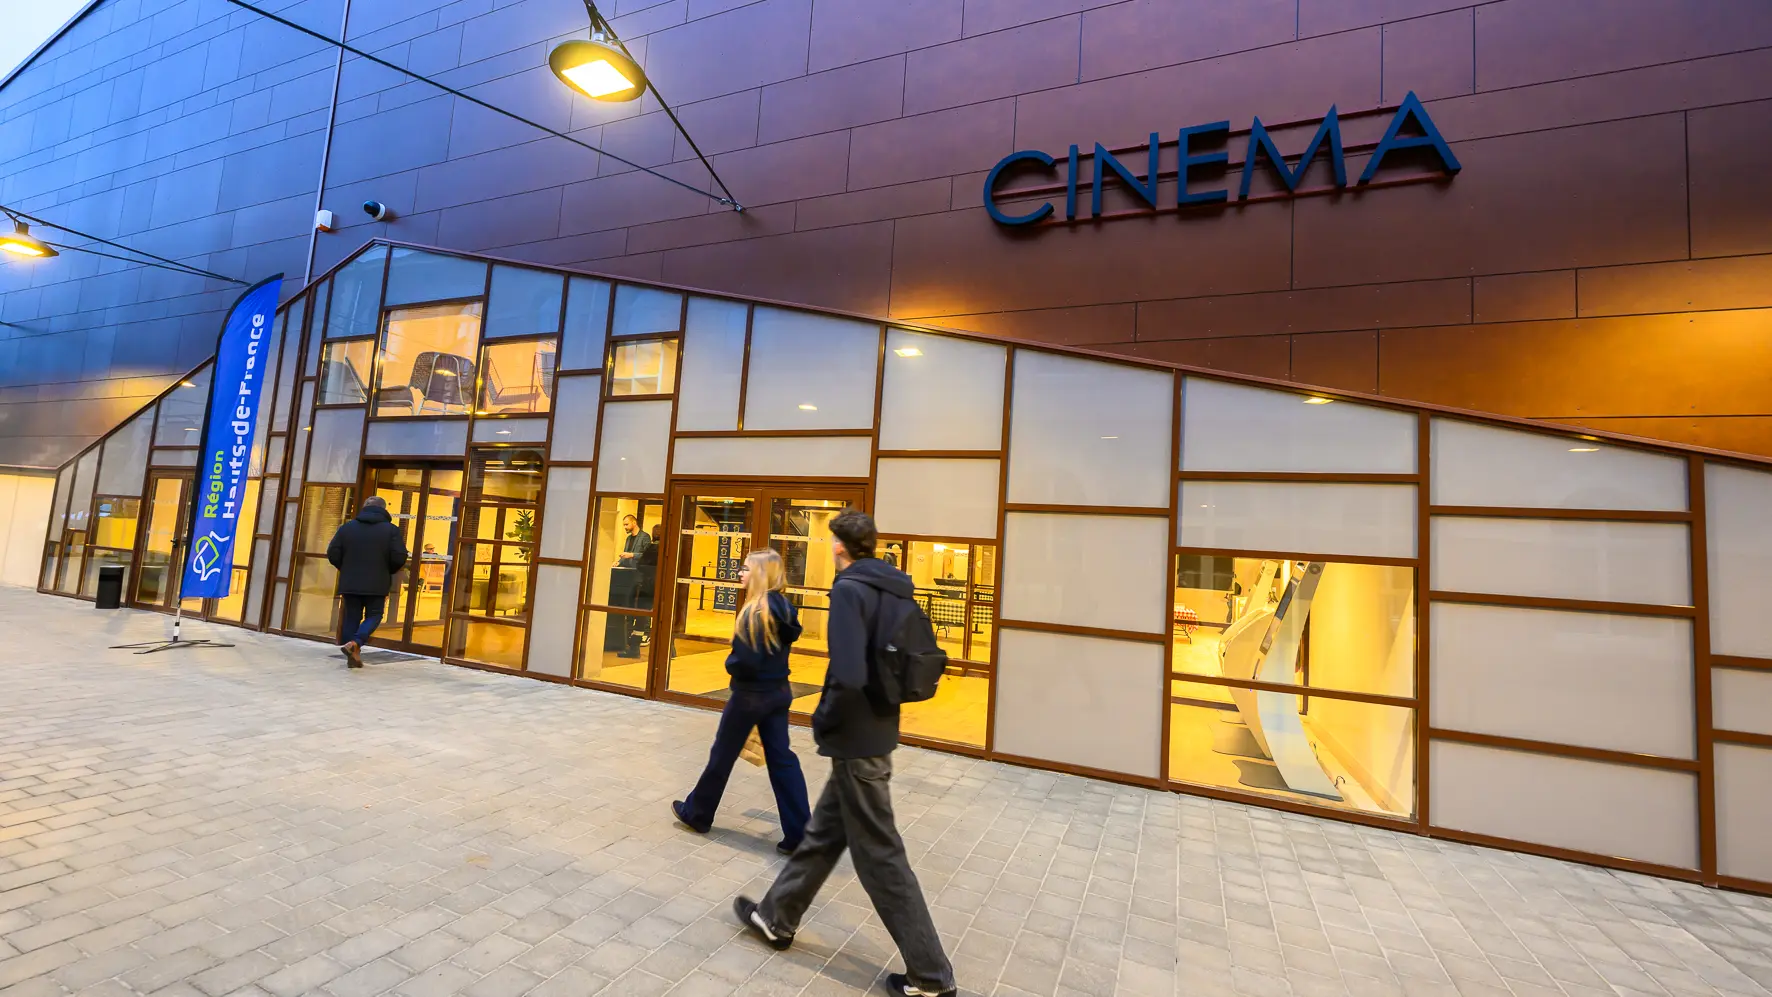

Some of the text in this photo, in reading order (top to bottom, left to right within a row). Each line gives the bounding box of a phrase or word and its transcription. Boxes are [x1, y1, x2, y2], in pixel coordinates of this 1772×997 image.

[983, 90, 1462, 226] CINEMA
[203, 450, 224, 519] Région
[222, 314, 265, 519] Hauts-de-France
